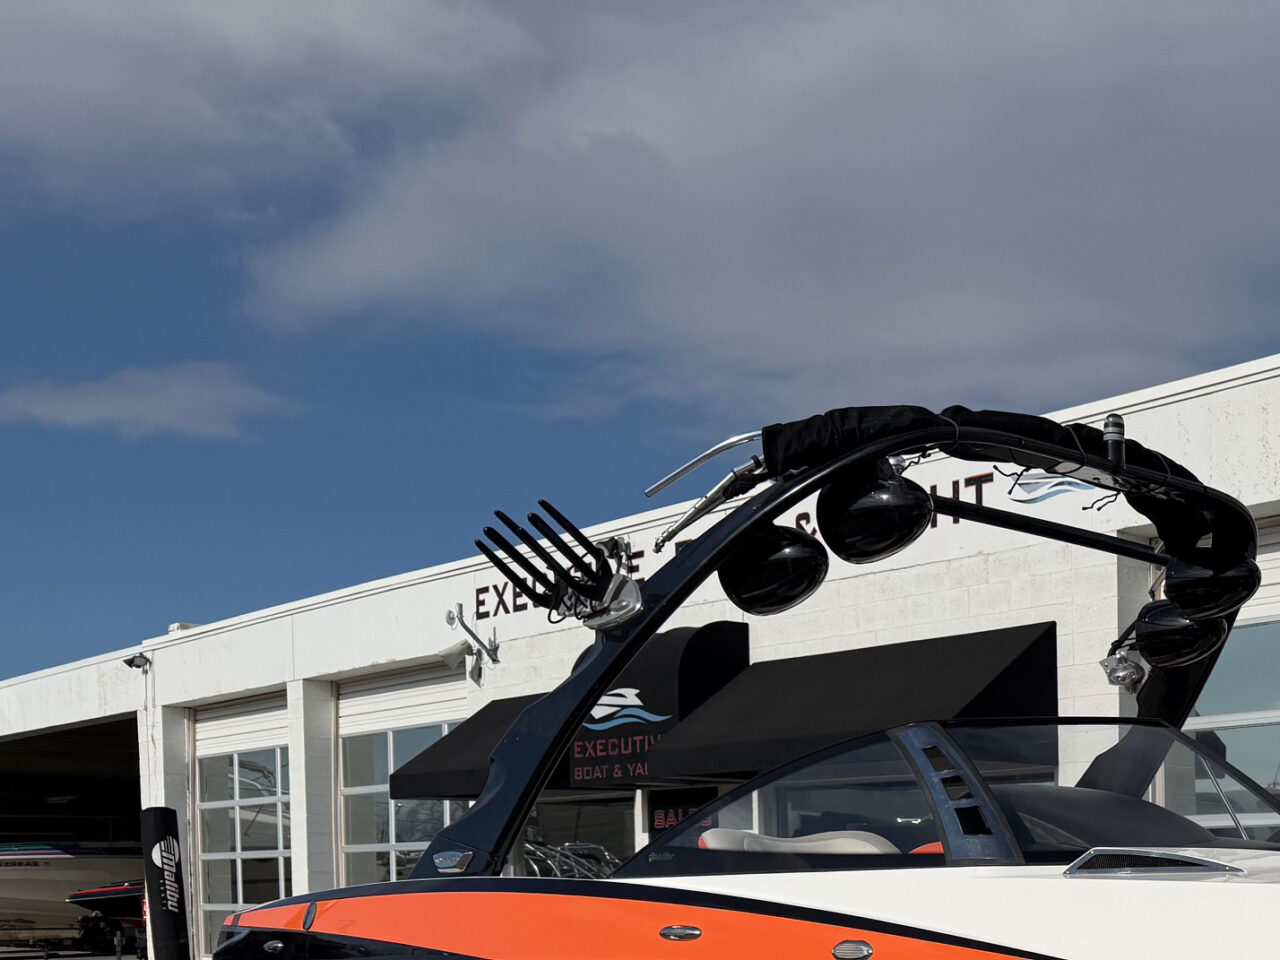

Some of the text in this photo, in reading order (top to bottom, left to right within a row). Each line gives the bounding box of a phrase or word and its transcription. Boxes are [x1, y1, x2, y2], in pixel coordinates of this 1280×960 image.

[574, 734, 663, 759] EXECUTIV
[574, 765, 609, 780] BOAT
[613, 763, 623, 777] &
